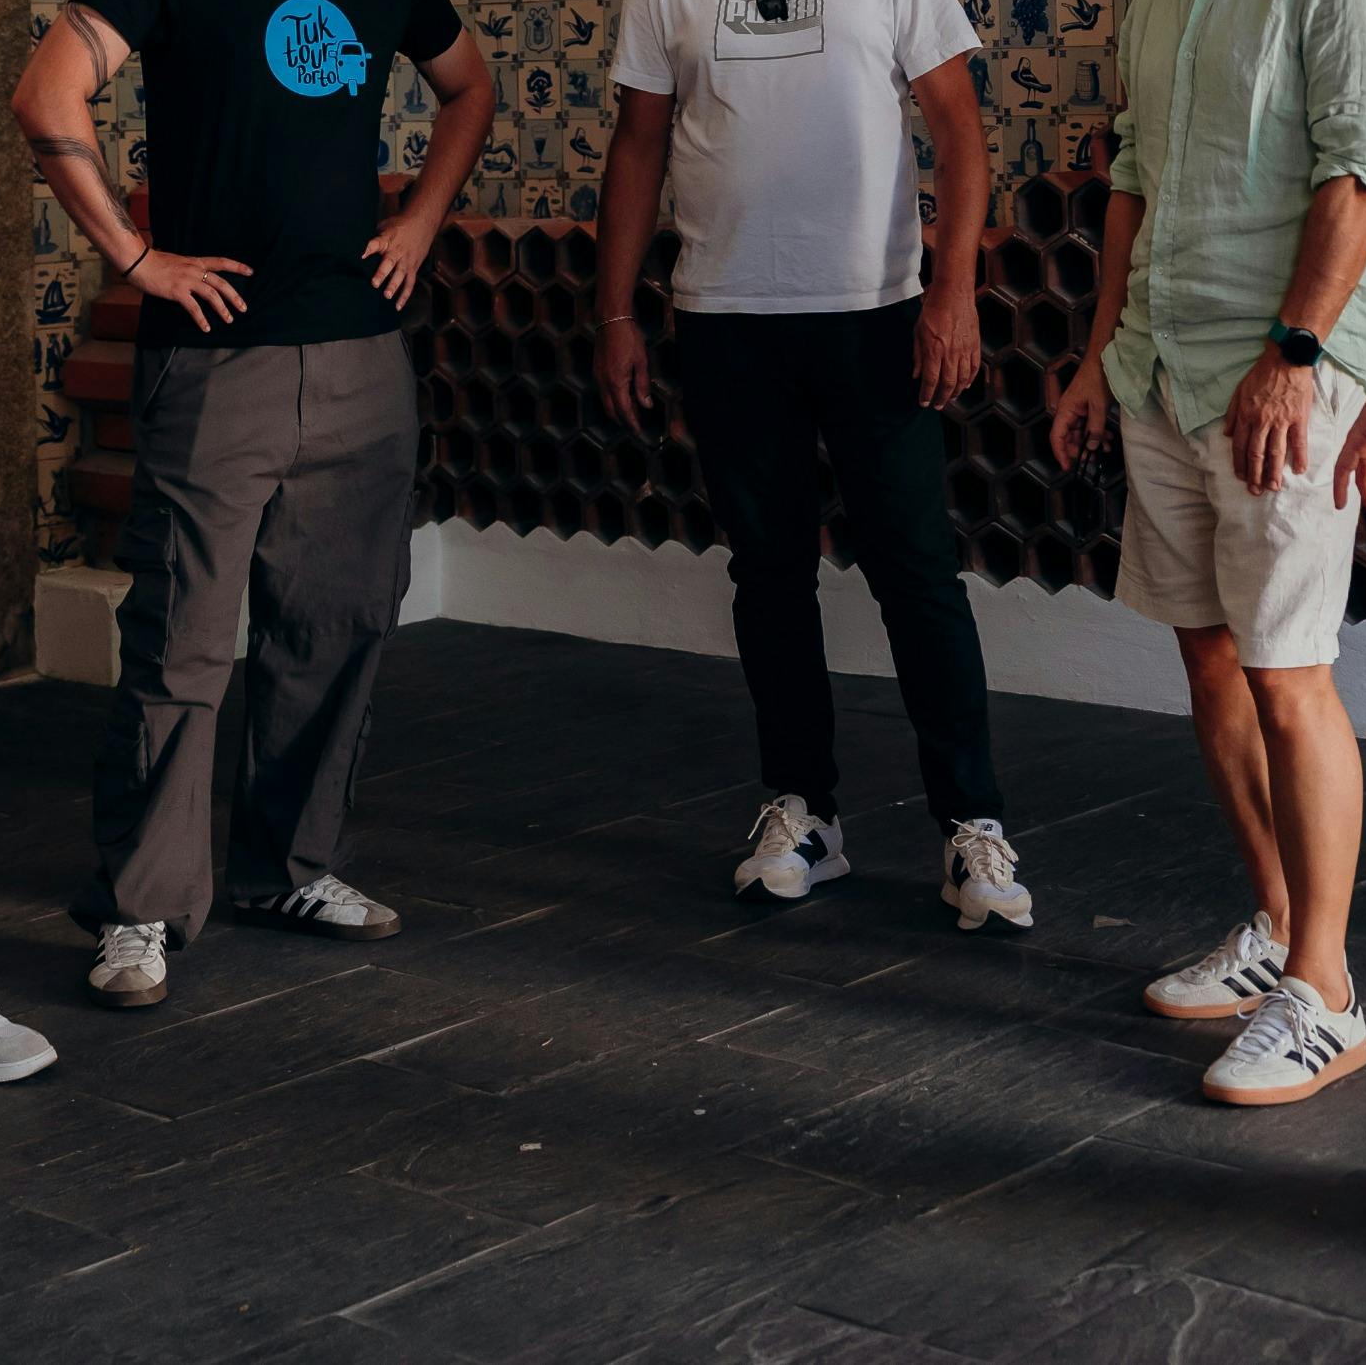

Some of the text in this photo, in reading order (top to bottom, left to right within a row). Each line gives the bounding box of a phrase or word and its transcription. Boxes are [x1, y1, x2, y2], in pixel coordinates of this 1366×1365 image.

[281, 5, 336, 45] Tuk
[283, 36, 337, 69] tour
[296, 65, 337, 87] Porto
